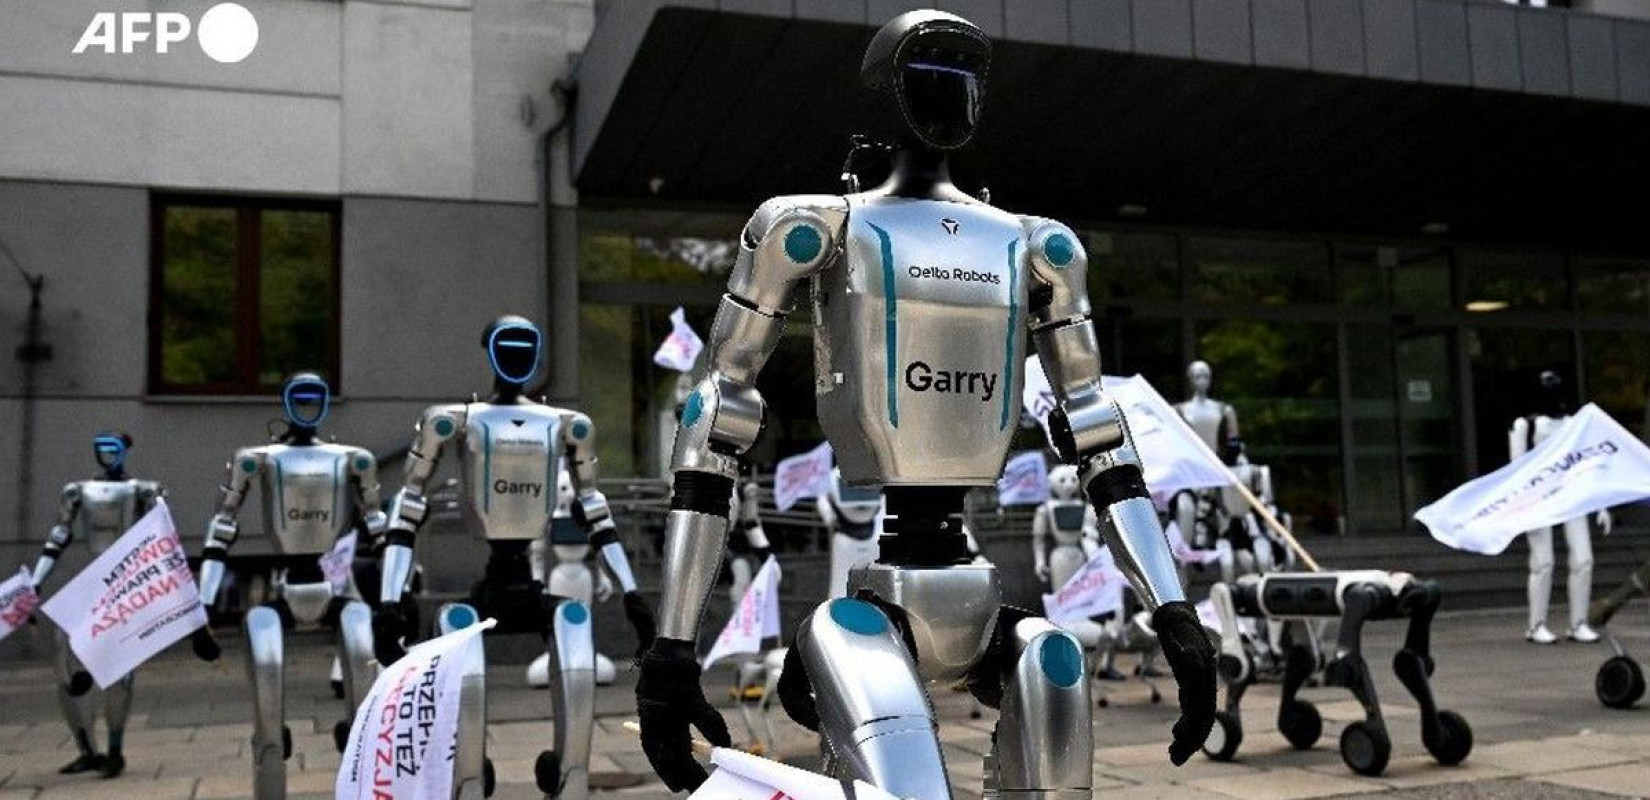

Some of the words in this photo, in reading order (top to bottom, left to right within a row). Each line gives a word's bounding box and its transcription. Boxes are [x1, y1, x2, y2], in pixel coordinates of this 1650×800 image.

[952, 267, 1001, 285] Robots
[905, 360, 998, 402] Garry
[494, 479, 542, 498] Garry
[288, 508, 330, 522] Garry
[399, 684, 417, 720] TO
[396, 727, 420, 778] TEŻ
